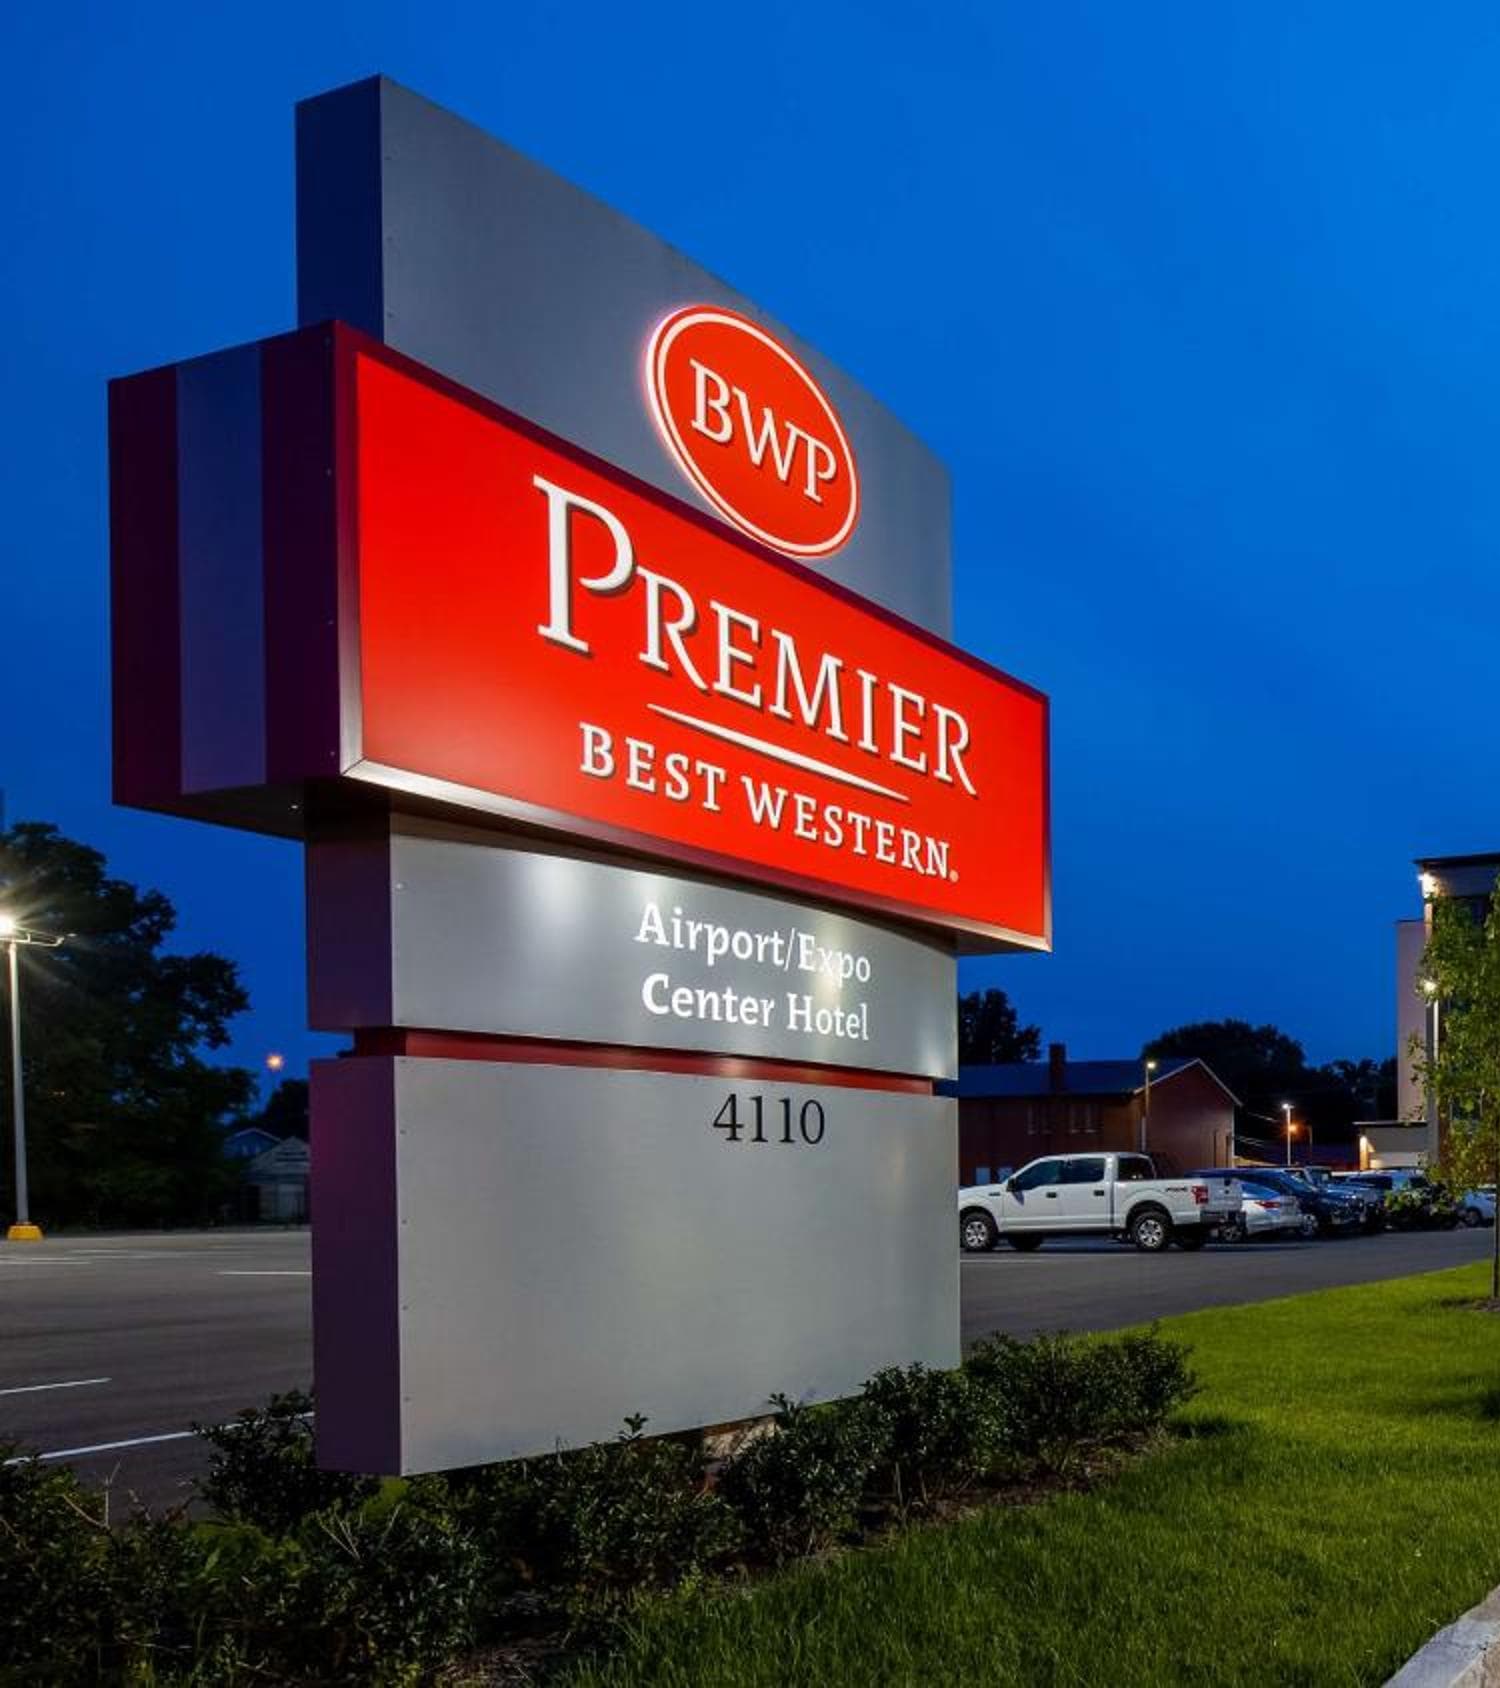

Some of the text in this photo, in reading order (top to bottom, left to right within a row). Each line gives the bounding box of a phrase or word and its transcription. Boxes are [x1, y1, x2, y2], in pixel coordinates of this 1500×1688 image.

[690, 358, 837, 503] BWP
[533, 474, 977, 797] PREMIER
[579, 722, 726, 811] BEST
[634, 902, 871, 986] Airport/Expo
[642, 973, 869, 1041] Center Hotel
[713, 1093, 826, 1144] 4110
